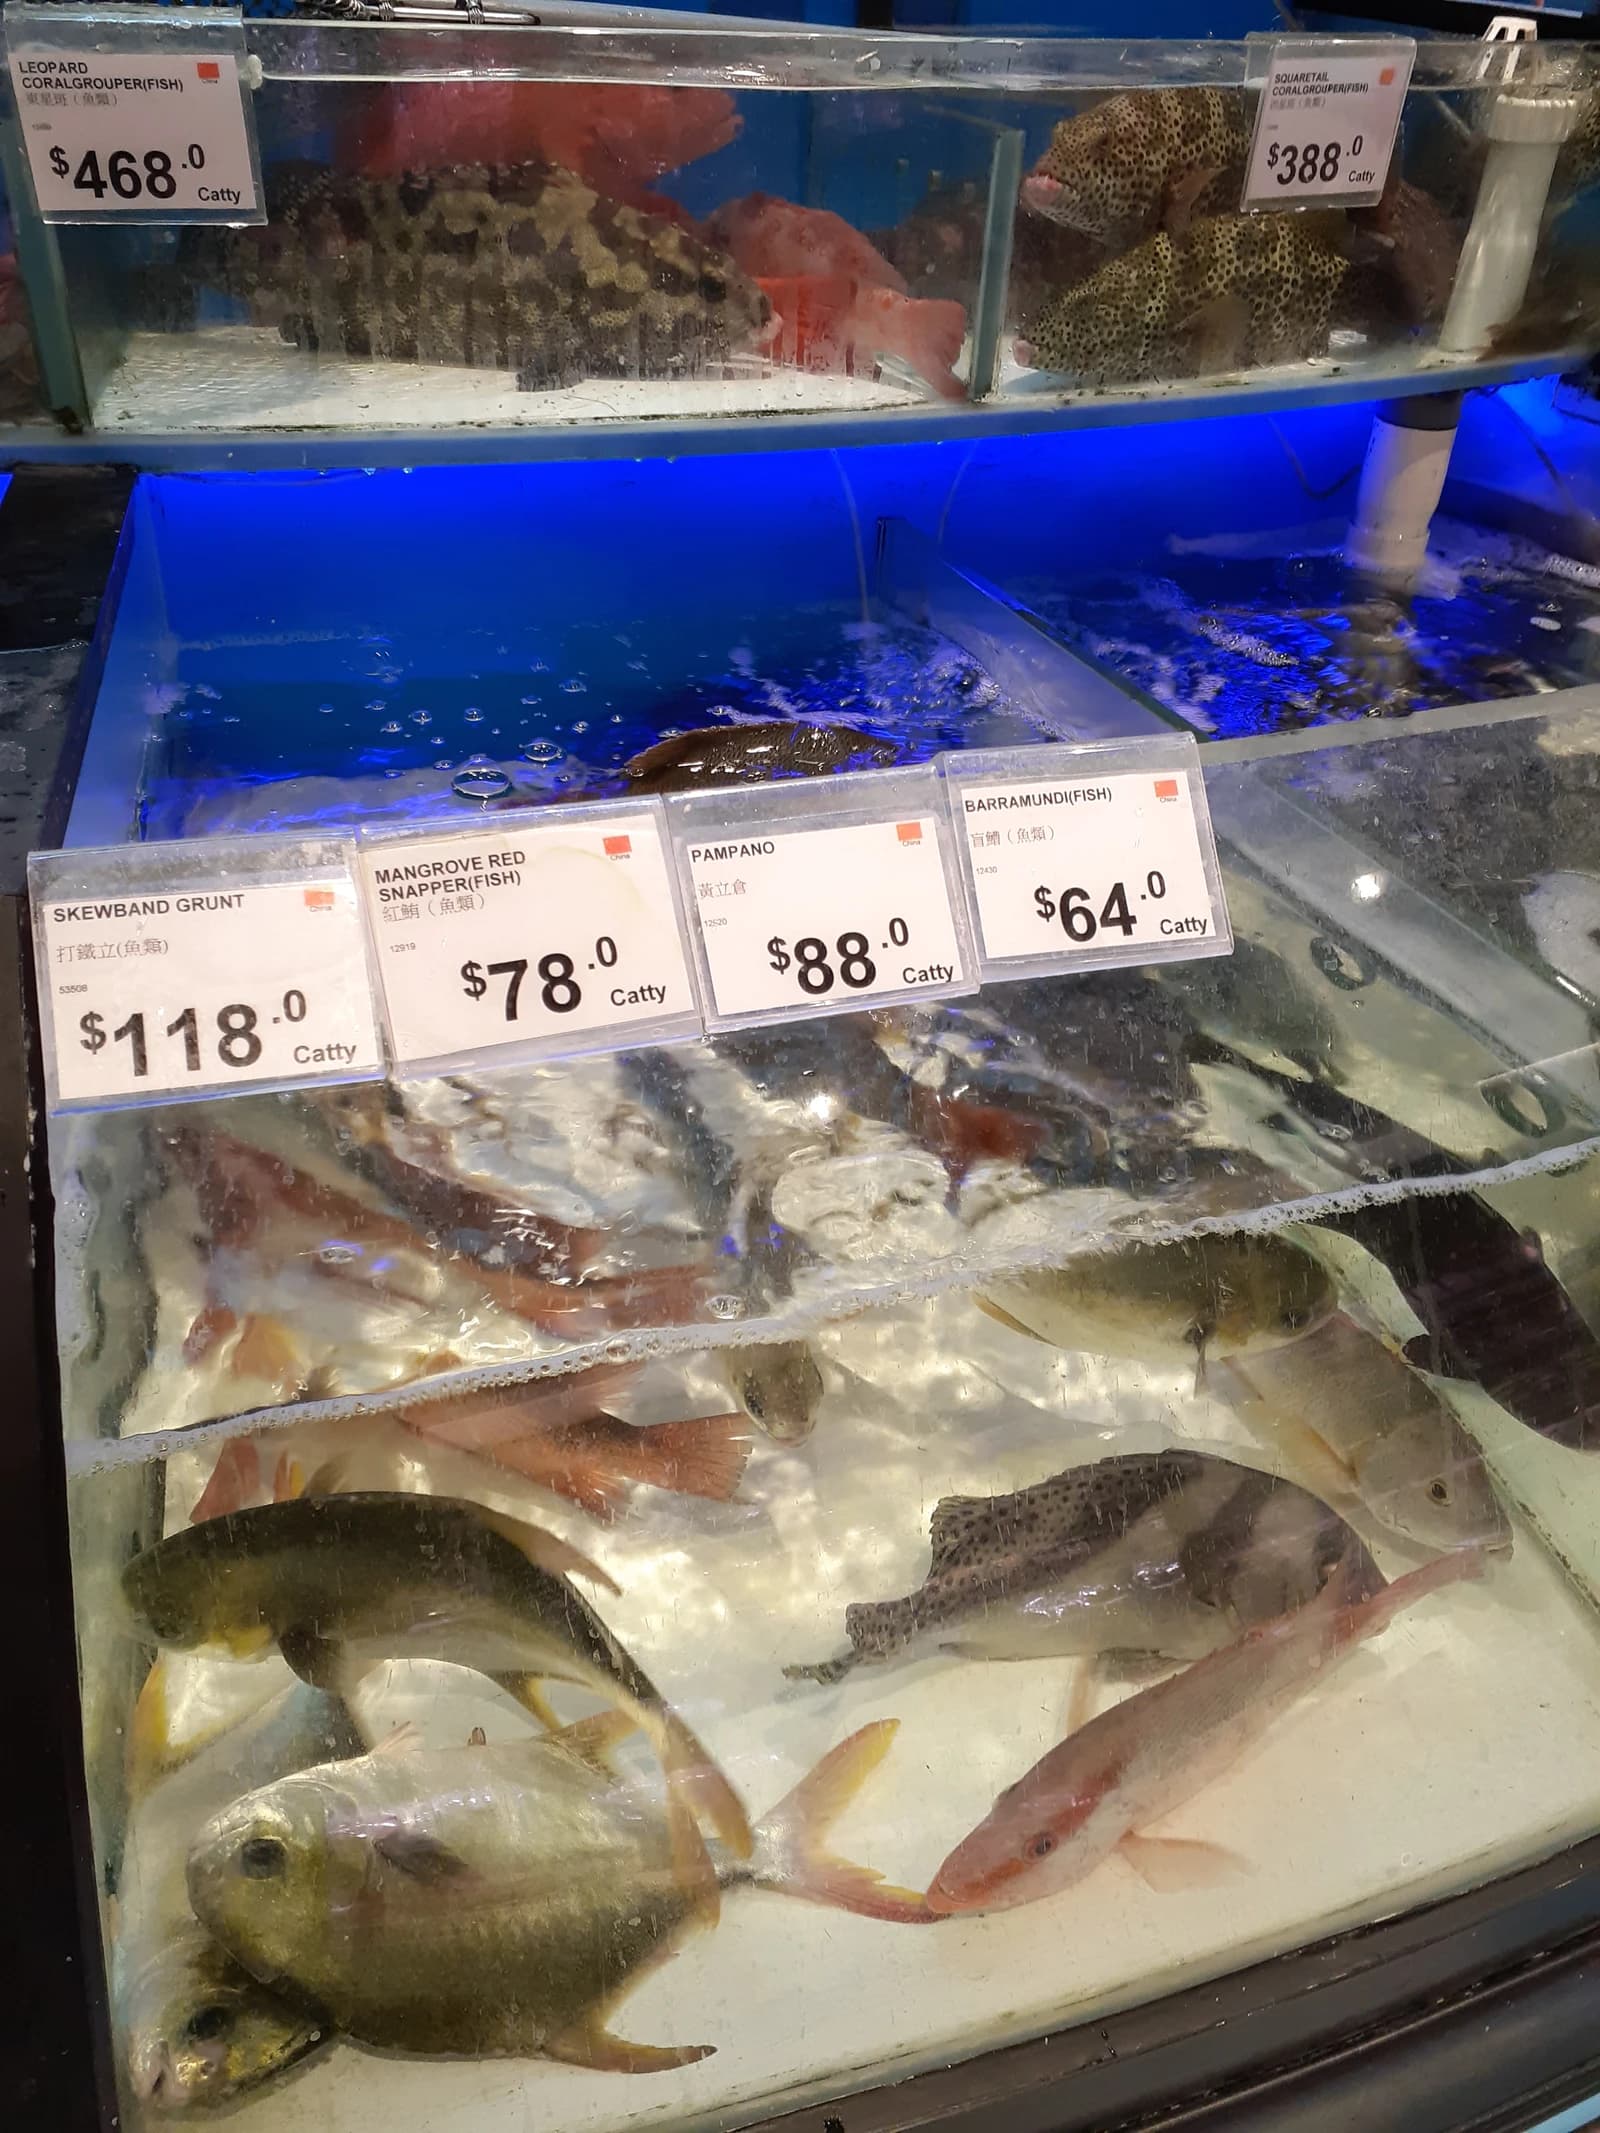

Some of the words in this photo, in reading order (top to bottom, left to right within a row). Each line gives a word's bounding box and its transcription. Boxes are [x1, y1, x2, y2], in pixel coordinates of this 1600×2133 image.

[18, 61, 88, 74] LEOPARD
[1274, 72, 1329, 83] SQUARETAIL
[22, 77, 184, 92] CORALGROUPER(FISH)
[1272, 83, 1369, 96] CORALGROUPER(FISH)
[1348, 169, 1376, 184] Catty
[198, 186, 241, 205] Catty
[965, 787, 1113, 813] BARRAMUNDI(FISH)
[610, 852, 631, 861] China
[691, 841, 775, 863] PAMPANO
[374, 856, 484, 885] MANGROVE
[489, 850, 526, 868] RED
[378, 870, 522, 903] SNAPPER(FISH)
[53, 900, 170, 923] SKEWBAND
[176, 893, 245, 913] GRUNT
[1159, 916, 1208, 936] Catty
[902, 964, 954, 985] Catty
[610, 984, 667, 1008] Catty
[293, 1042, 357, 1065] Catty
